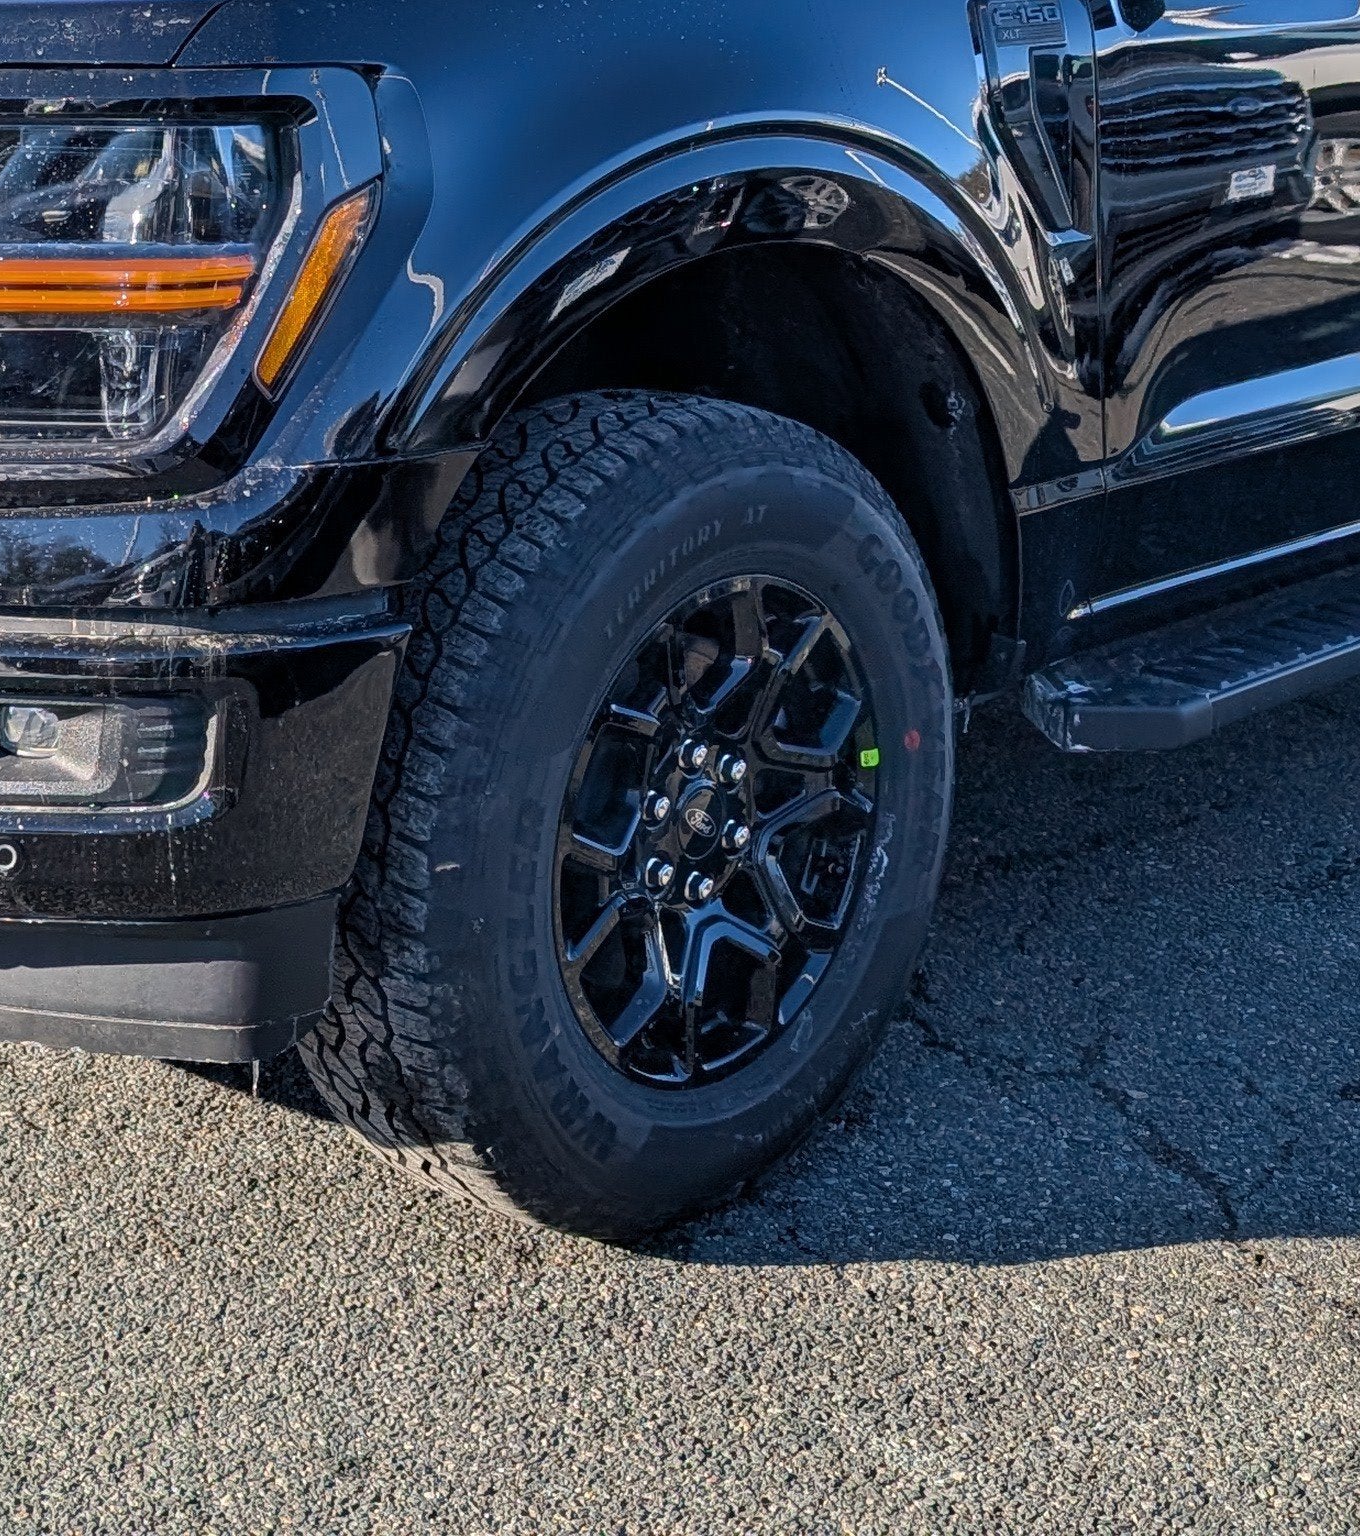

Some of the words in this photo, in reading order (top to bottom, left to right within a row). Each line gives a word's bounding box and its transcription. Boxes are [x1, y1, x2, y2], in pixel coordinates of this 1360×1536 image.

[993, 5, 1061, 26] F-150
[1001, 29, 1021, 40] XLT
[602, 517, 725, 641] TERRITORY
[690, 811, 713, 835] Ford
